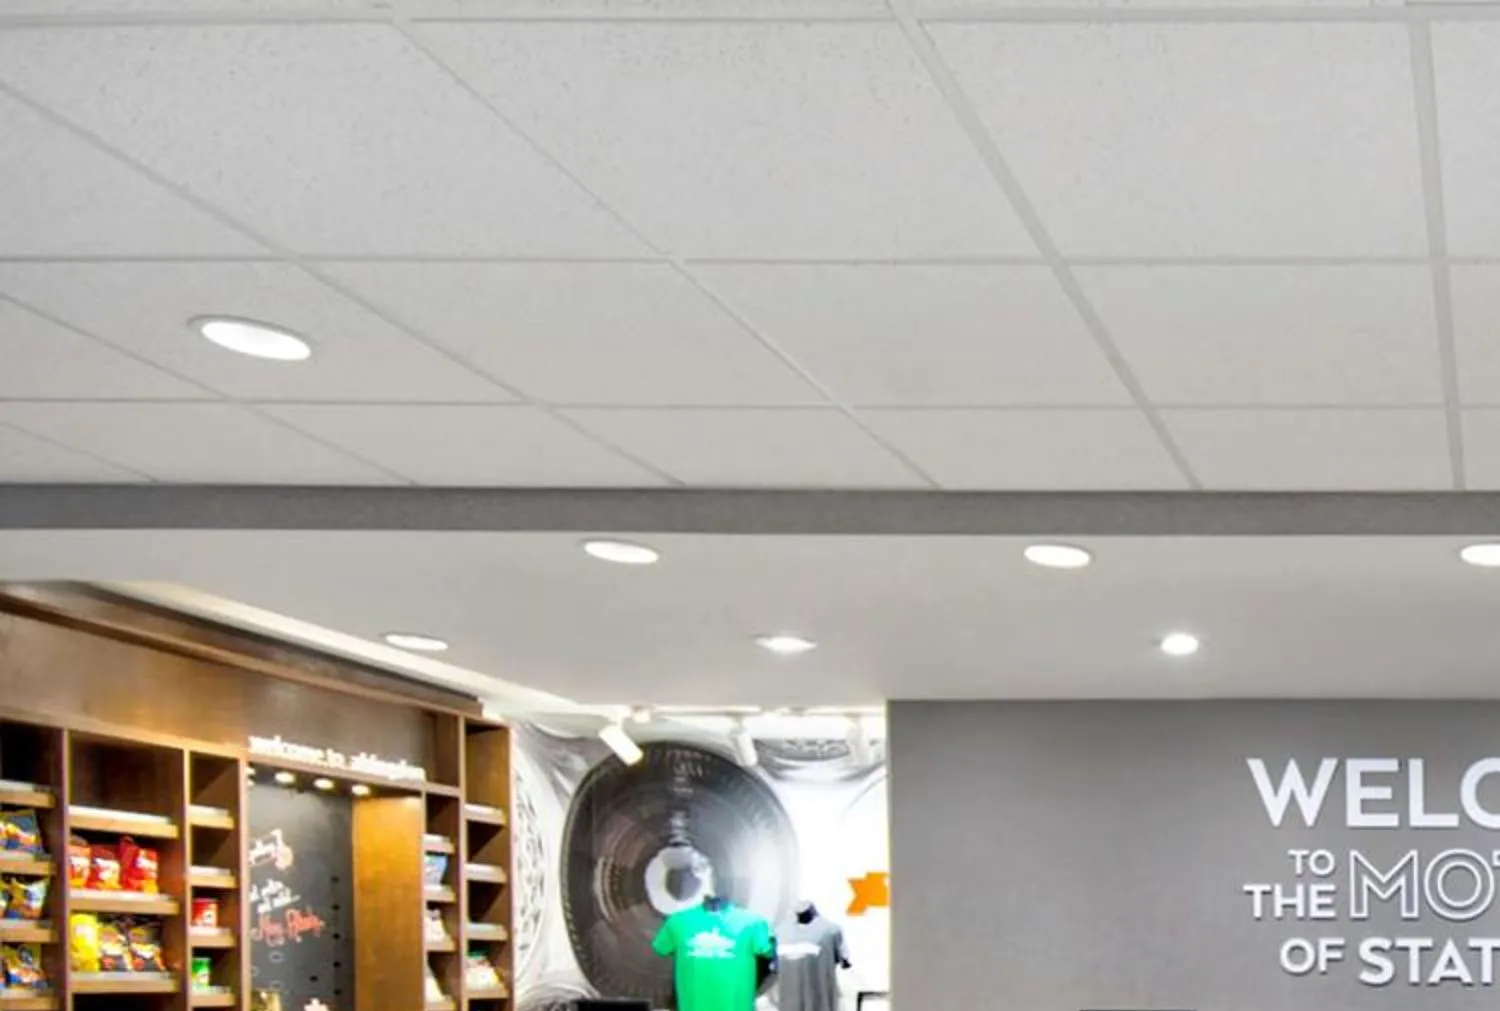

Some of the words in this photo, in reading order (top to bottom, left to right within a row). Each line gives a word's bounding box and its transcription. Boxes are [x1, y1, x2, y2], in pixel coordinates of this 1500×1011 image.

[1288, 849, 1336, 877] TO
[1243, 883, 1337, 919] THE
[1279, 938, 1345, 975] OF
